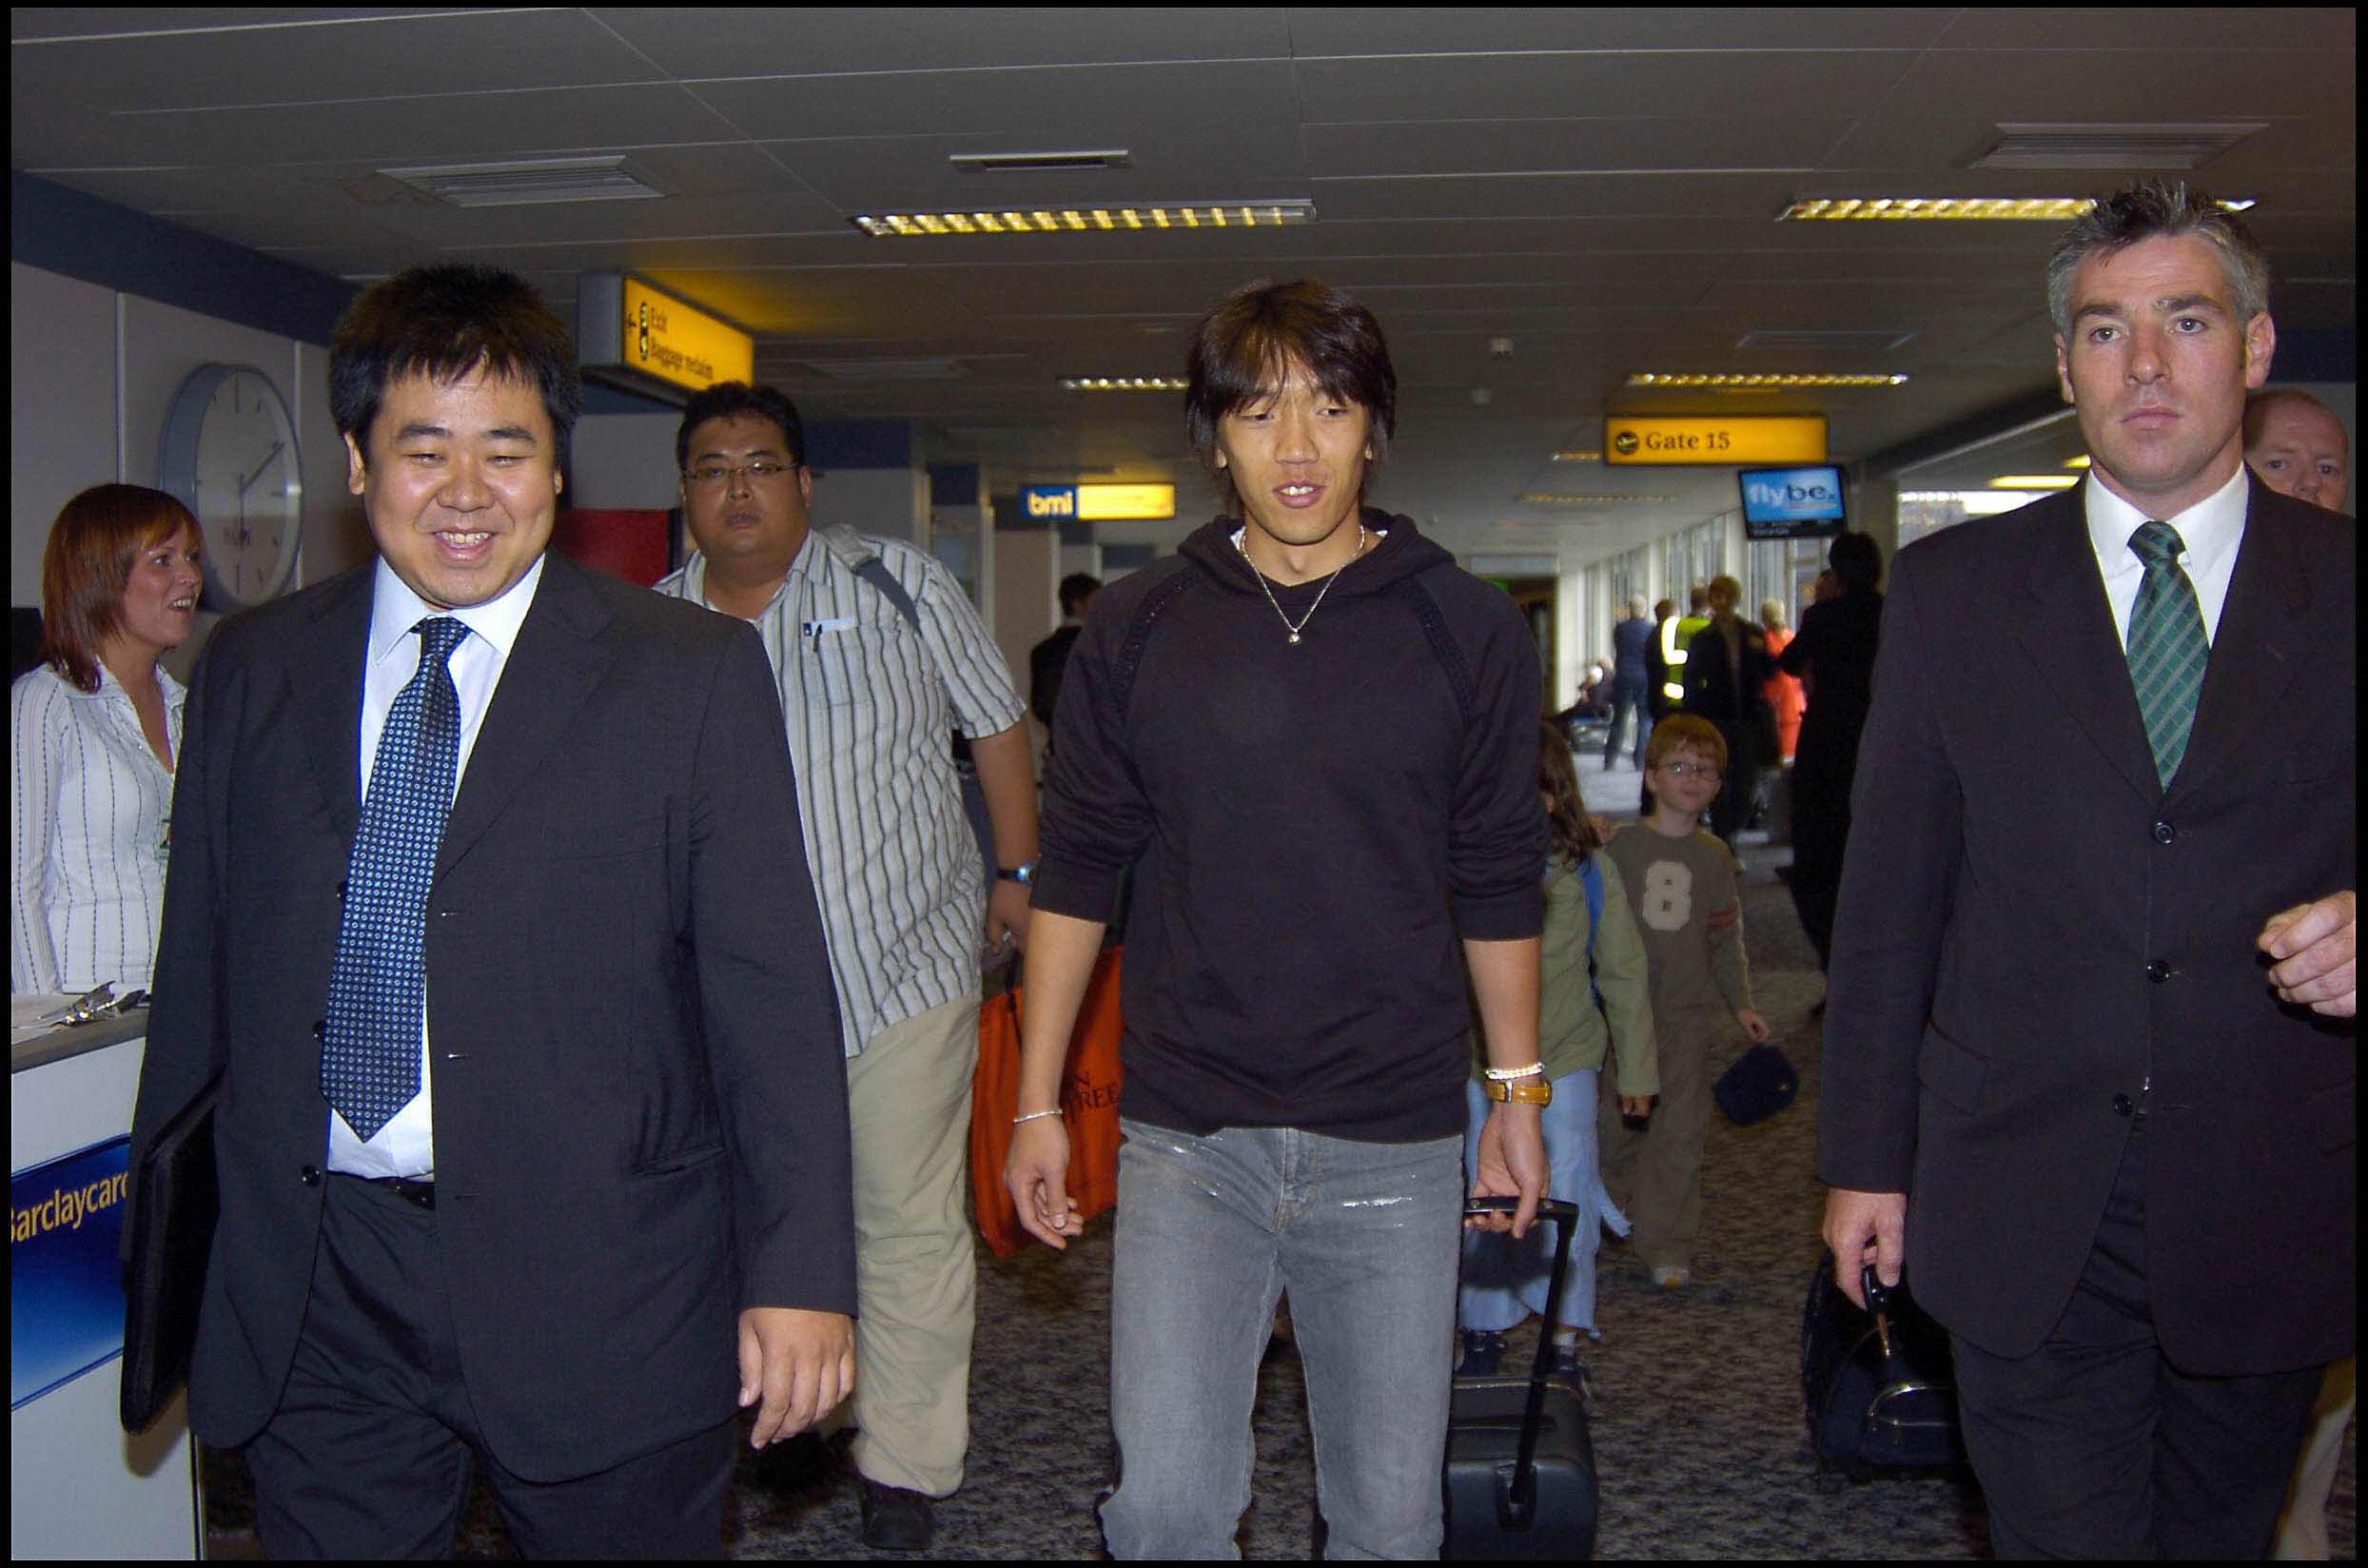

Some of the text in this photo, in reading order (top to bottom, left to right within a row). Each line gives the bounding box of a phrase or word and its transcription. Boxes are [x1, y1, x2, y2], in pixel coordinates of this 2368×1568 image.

[1646, 432, 1731, 451] Gate 15
[1027, 490, 1072, 517] bmi
[1642, 860, 1692, 931] 8
